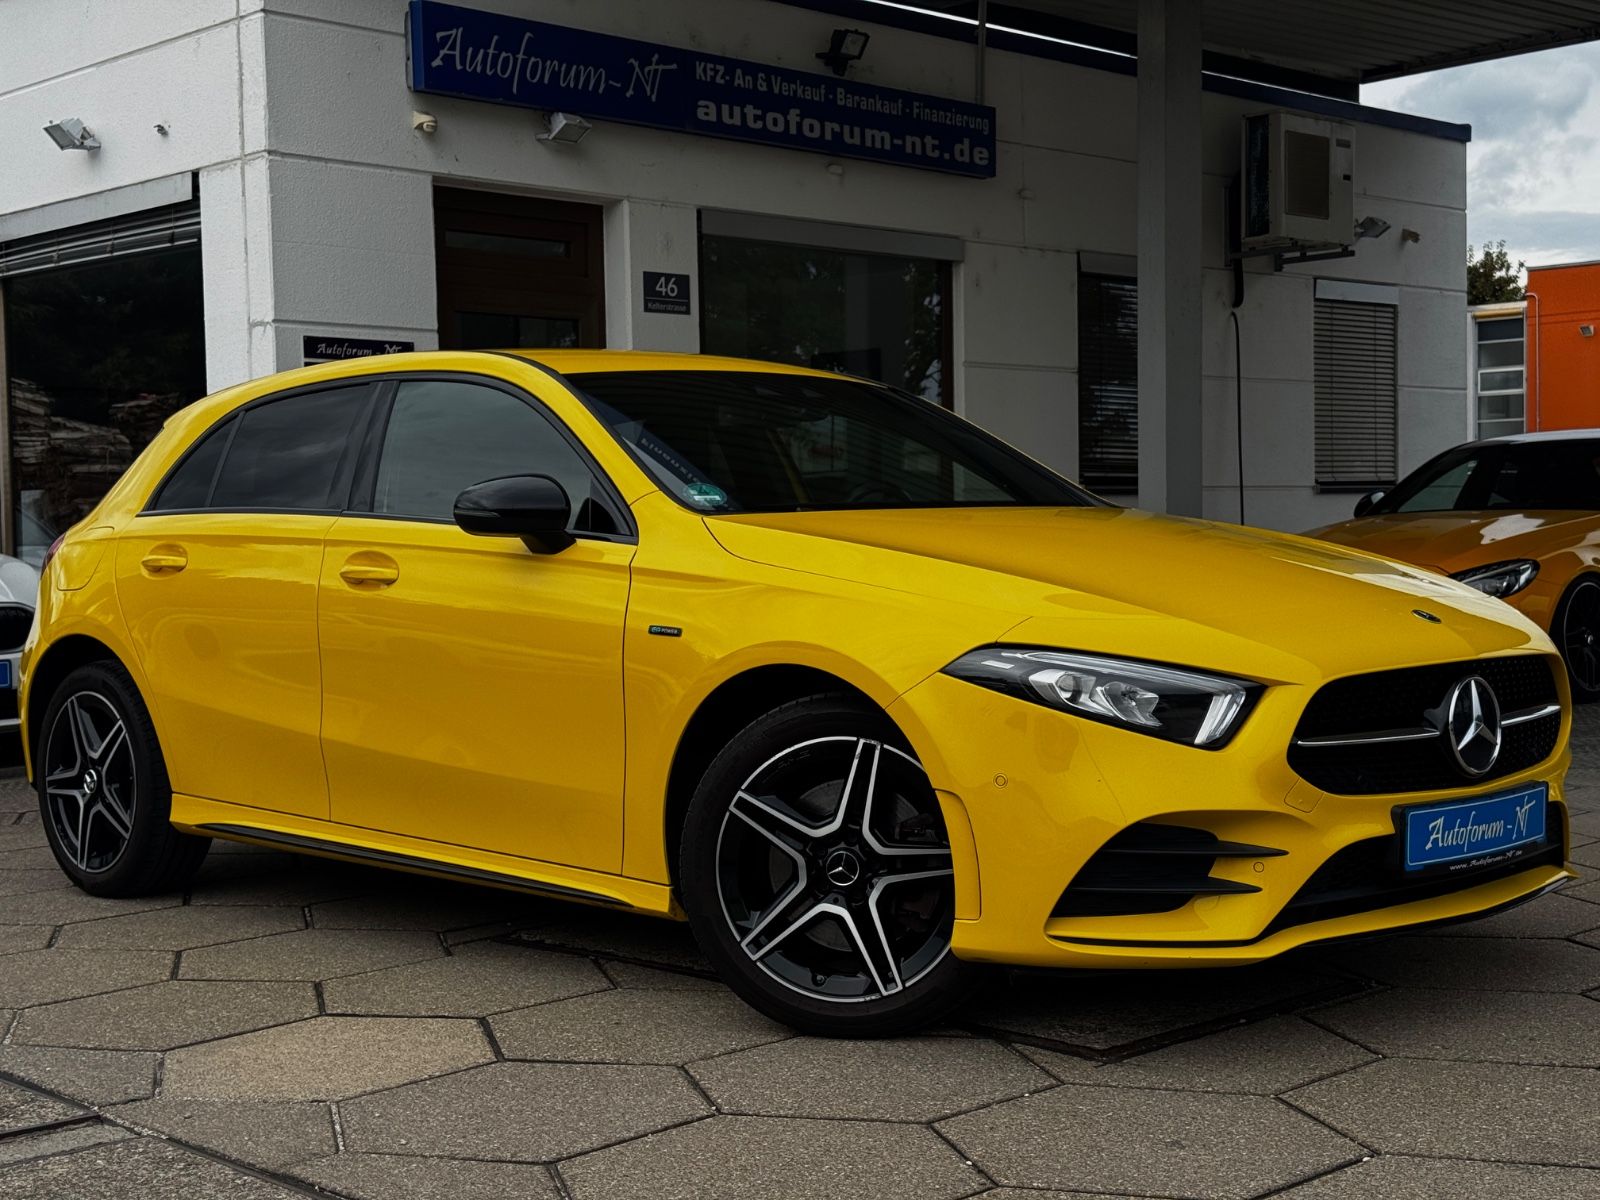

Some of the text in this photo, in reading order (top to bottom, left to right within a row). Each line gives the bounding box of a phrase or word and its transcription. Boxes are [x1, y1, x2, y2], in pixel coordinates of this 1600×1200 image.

[734, 68, 753, 89] An
[756, 72, 768, 91] &
[771, 74, 826, 102] Verkauf
[837, 87, 903, 116] Barankauf
[913, 101, 989, 135] Finanzierung
[696, 99, 990, 166] autoforum-nt.de
[655, 276, 678, 297] 46
[316, 342, 373, 358] Autoforum
